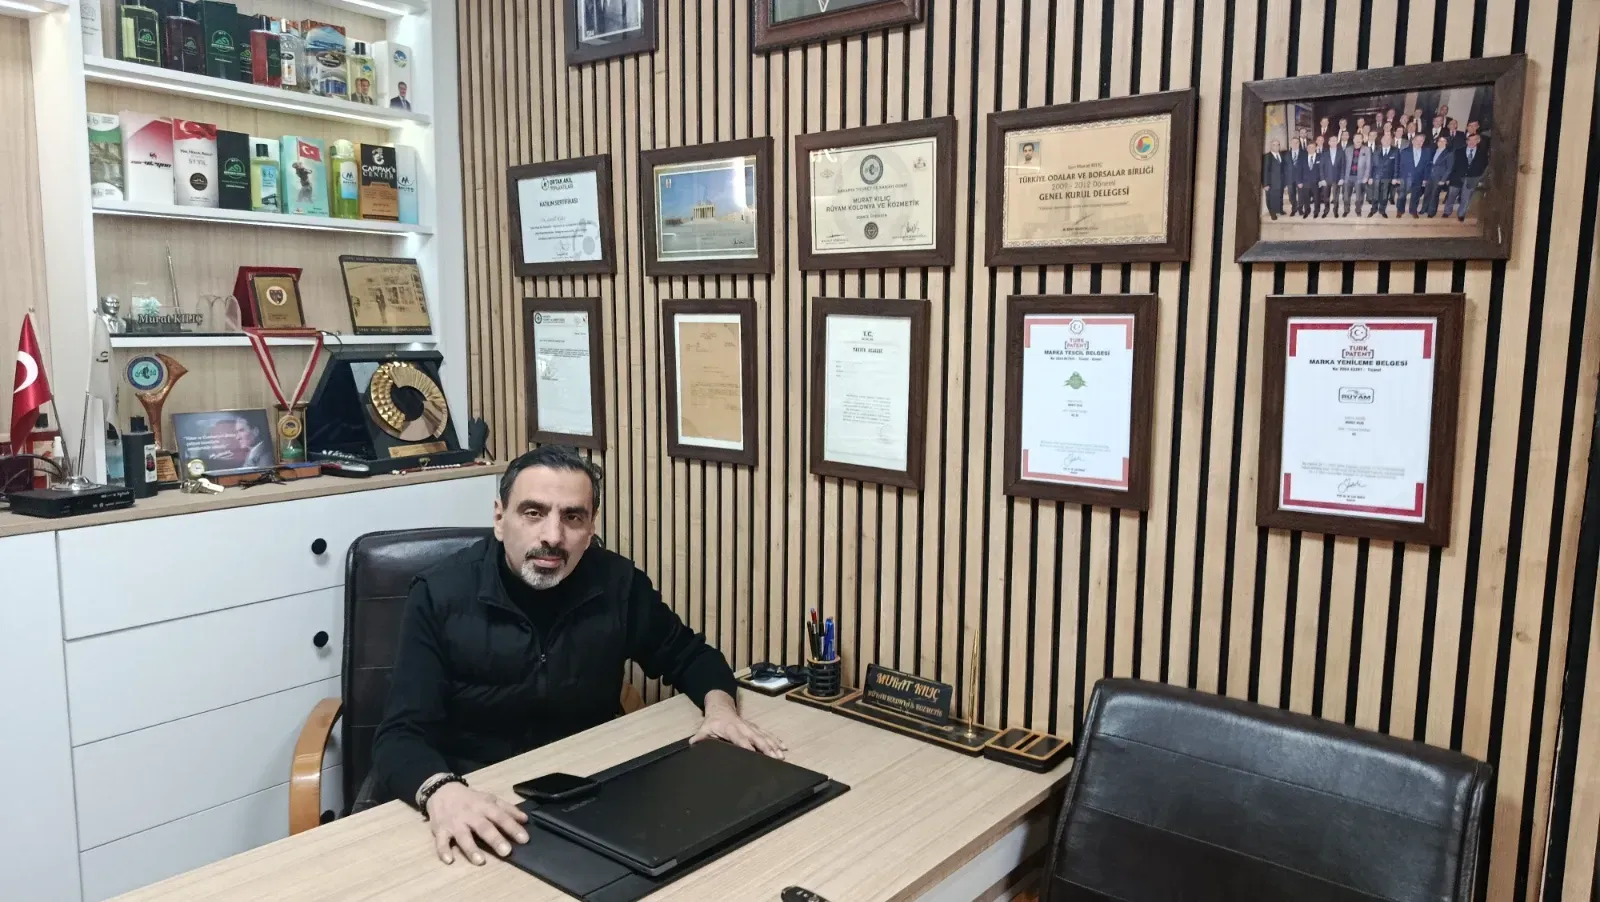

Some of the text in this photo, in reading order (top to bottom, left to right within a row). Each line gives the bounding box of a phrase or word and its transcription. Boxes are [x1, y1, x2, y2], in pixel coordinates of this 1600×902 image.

[1019, 176, 1046, 184] TÜRKİYE
[1088, 170, 1126, 178] BORSALAR
[1128, 165, 1154, 176] BİRLİĞİ
[1039, 186, 1129, 201] GENEL KURUL DELEGESİ
[826, 204, 846, 212] RÜYAM
[888, 200, 920, 208] KOZMETİK
[138, 314, 203, 326] Murat KILIÇ
[1337, 358, 1373, 366] YENİLEME
[876, 673, 940, 700] MURAT KILIÇ
